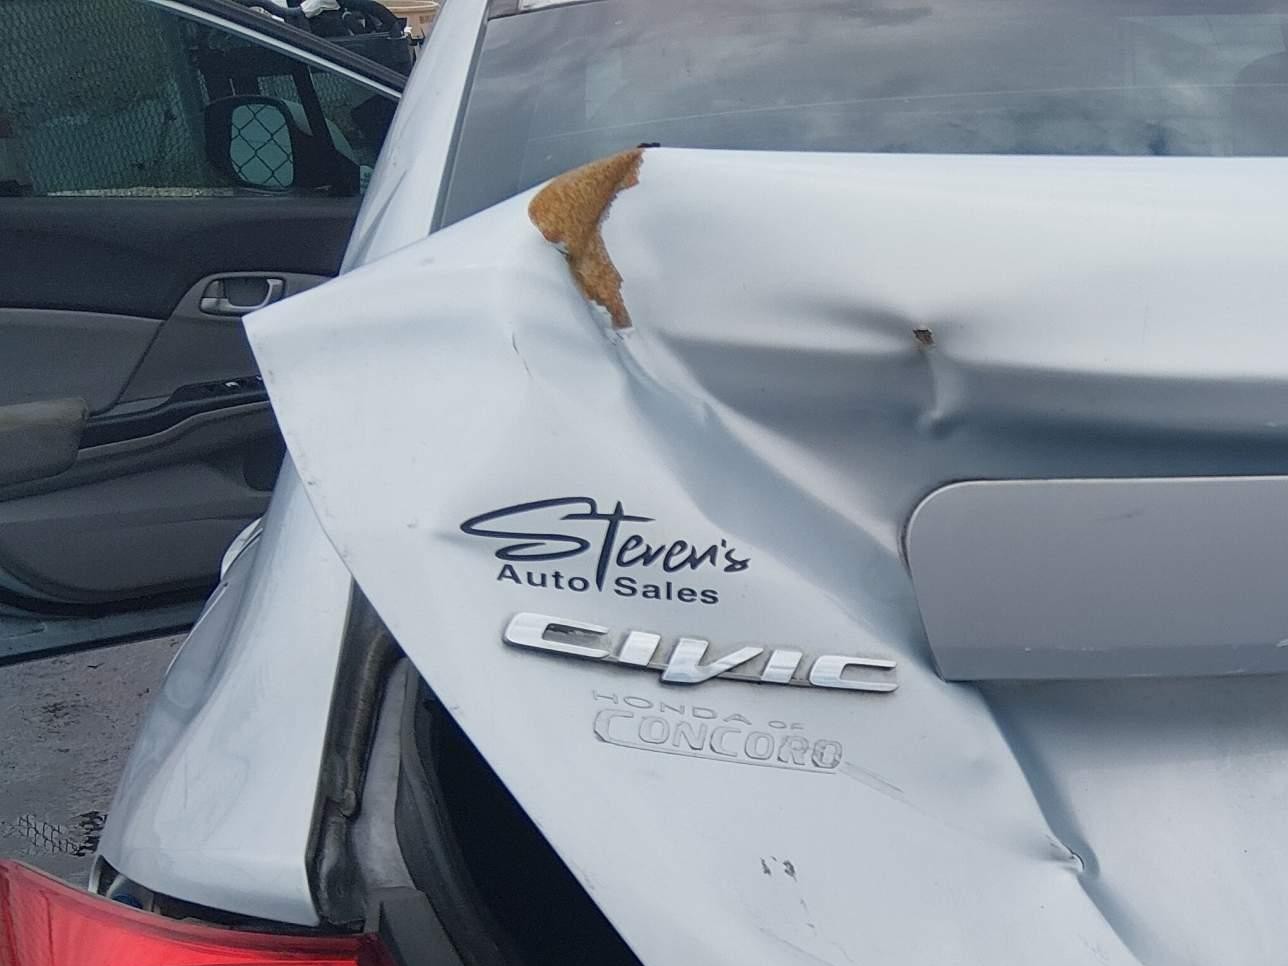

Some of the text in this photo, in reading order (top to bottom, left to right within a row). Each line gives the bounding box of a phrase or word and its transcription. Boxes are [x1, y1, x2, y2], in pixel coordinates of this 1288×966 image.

[459, 496, 751, 592] Steven's
[496, 563, 720, 605] Auto Sales
[502, 612, 900, 692] CIVIC
[592, 690, 805, 731] HONDA OF
